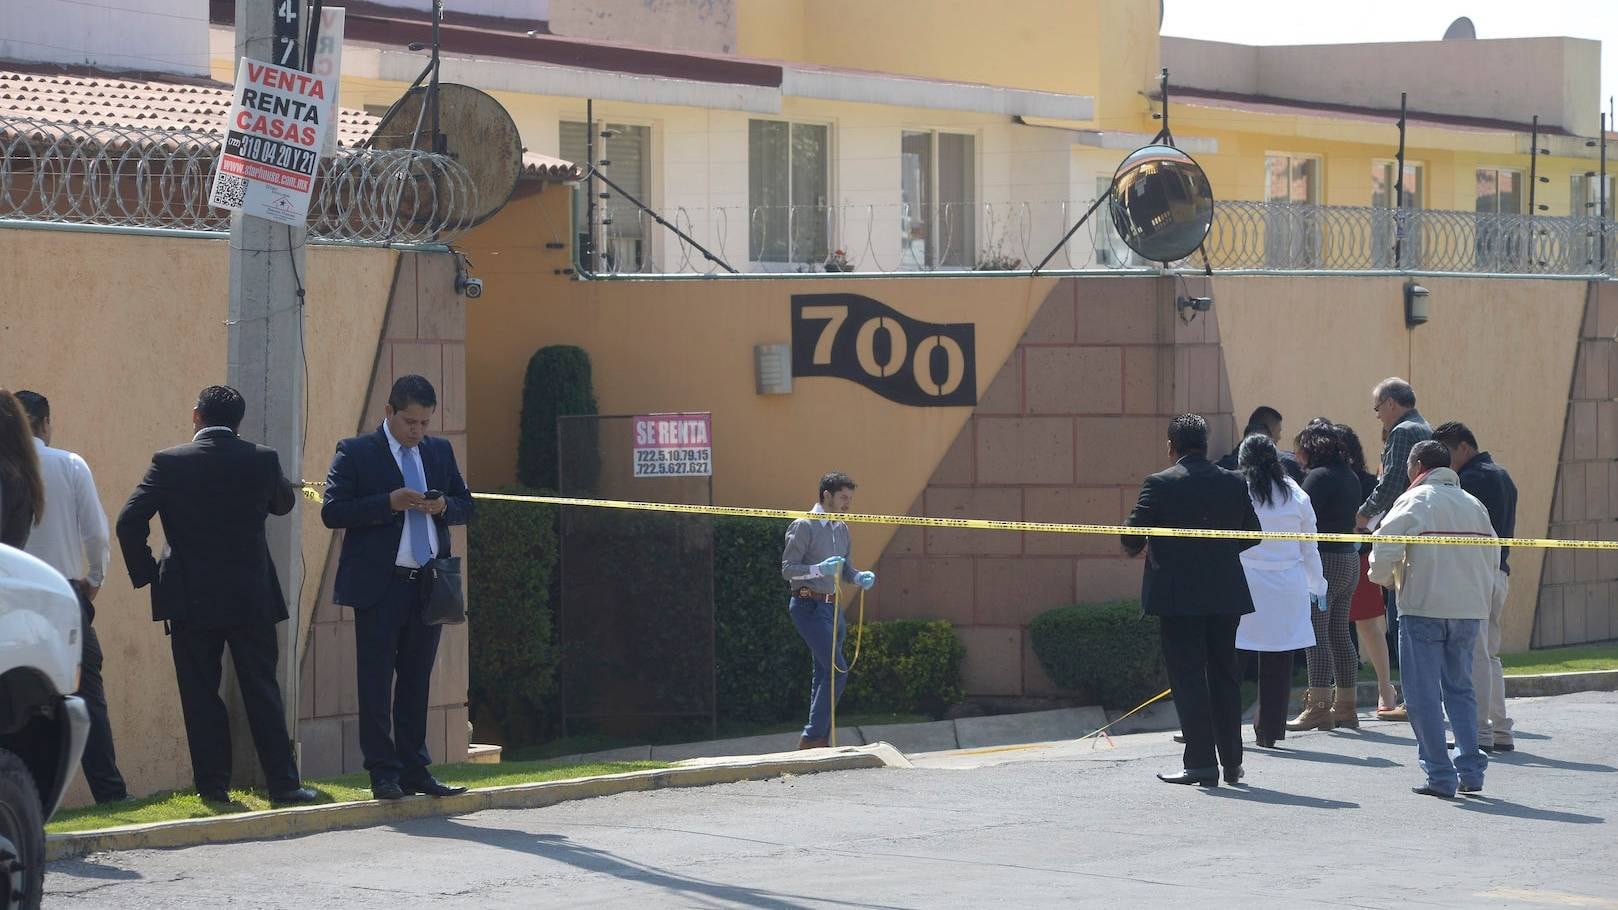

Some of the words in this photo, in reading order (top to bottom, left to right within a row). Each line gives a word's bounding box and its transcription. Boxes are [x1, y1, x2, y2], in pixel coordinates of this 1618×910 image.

[248, 63, 324, 100] VENTA
[241, 88, 319, 125] RENTA
[236, 111, 316, 146] CASAS
[240, 135, 261, 160] 319
[261, 141, 277, 164] 04
[278, 144, 292, 167] 20
[292, 148, 302, 170] Y
[300, 151, 315, 174] 21
[801, 305, 965, 396] 700
[636, 420, 656, 445] SE
[658, 419, 708, 444] RENTA
[637, 449, 709, 462] 722.5.10.79.15
